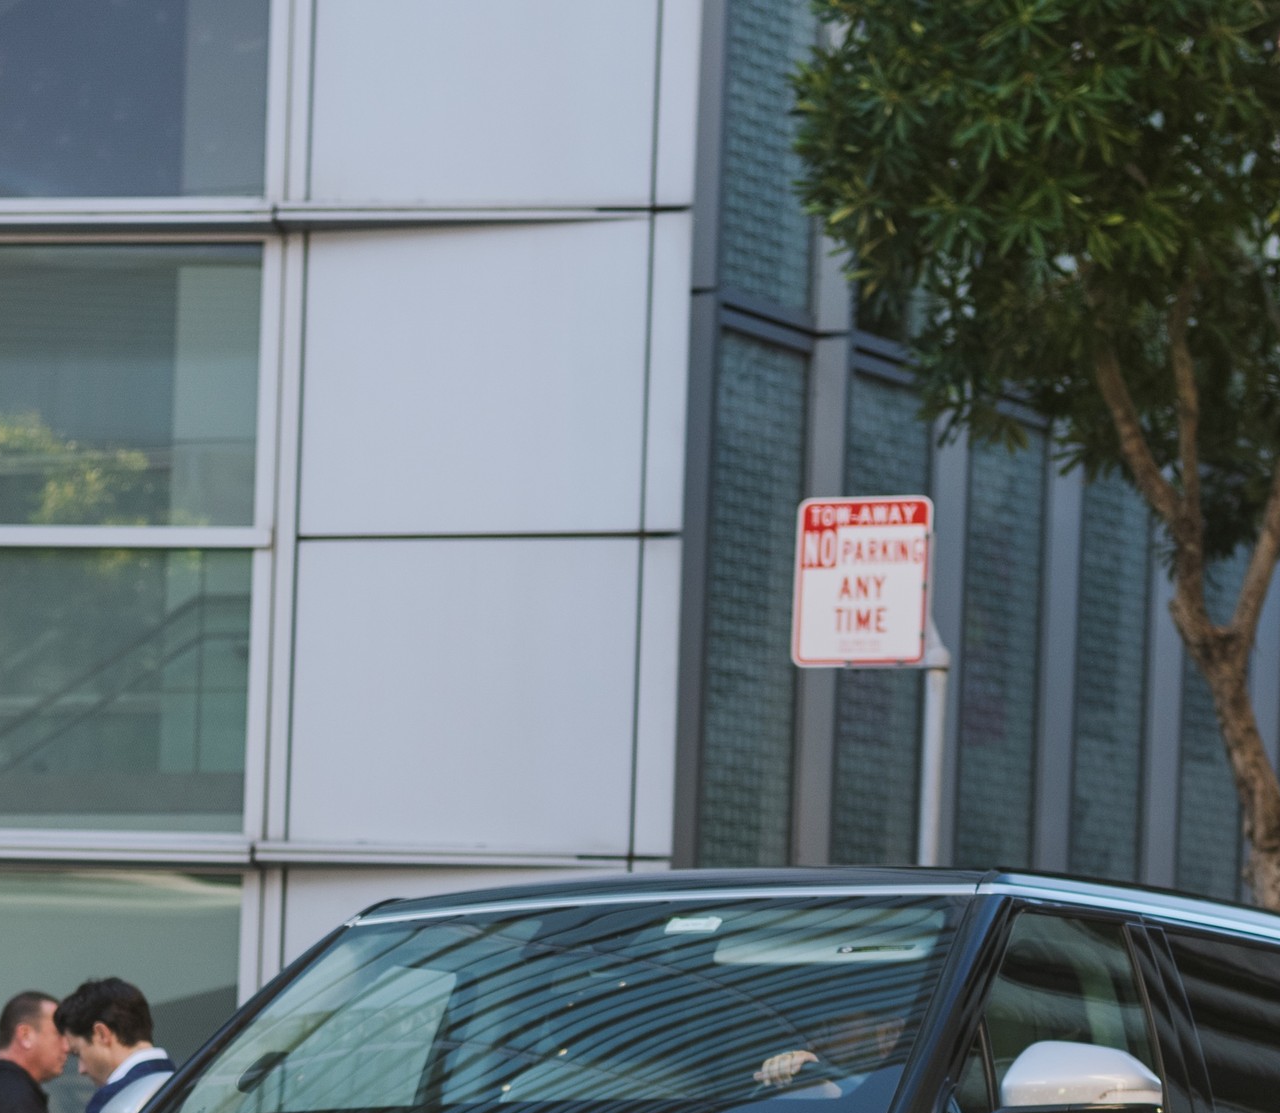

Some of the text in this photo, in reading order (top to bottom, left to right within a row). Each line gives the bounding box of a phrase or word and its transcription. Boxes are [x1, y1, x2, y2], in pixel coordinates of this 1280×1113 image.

[811, 504, 917, 527] TOW-AWAY
[805, 529, 925, 567] NO PARKING
[838, 576, 886, 600] ANY
[835, 607, 888, 633] TIME
